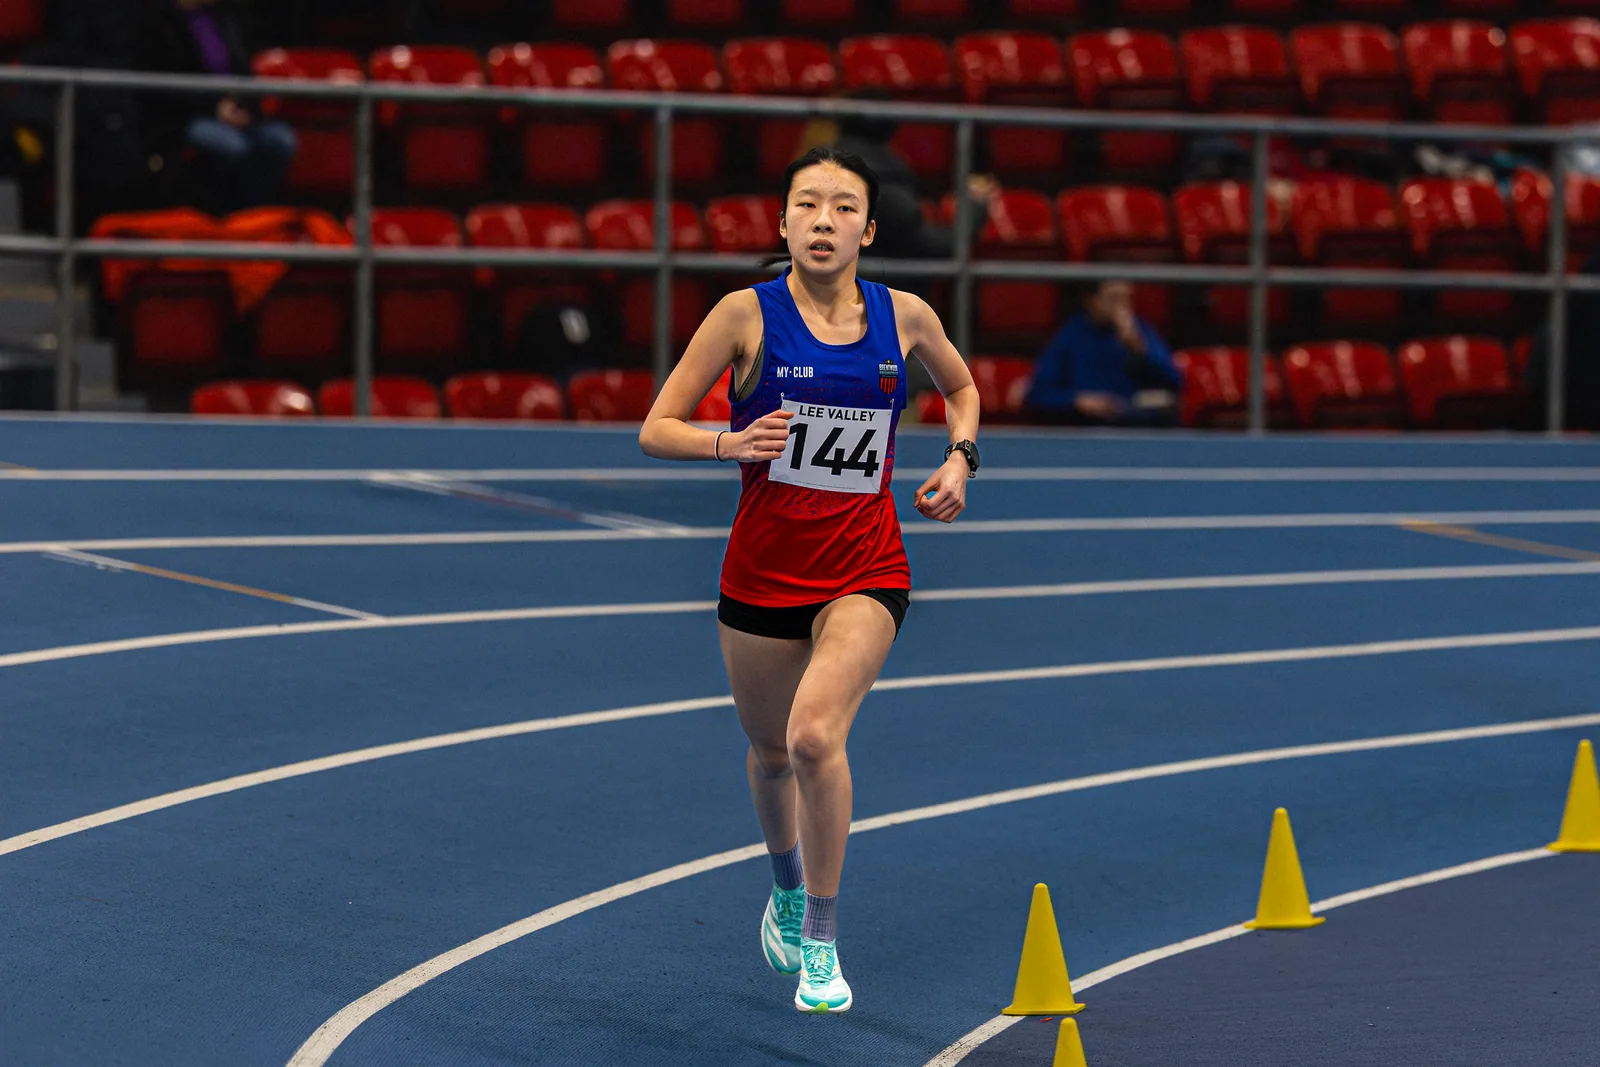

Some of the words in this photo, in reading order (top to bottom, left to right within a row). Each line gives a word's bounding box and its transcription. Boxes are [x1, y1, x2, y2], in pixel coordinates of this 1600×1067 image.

[799, 405, 825, 418] LEE
[828, 408, 876, 421] VALLEY
[789, 423, 880, 477] 144
